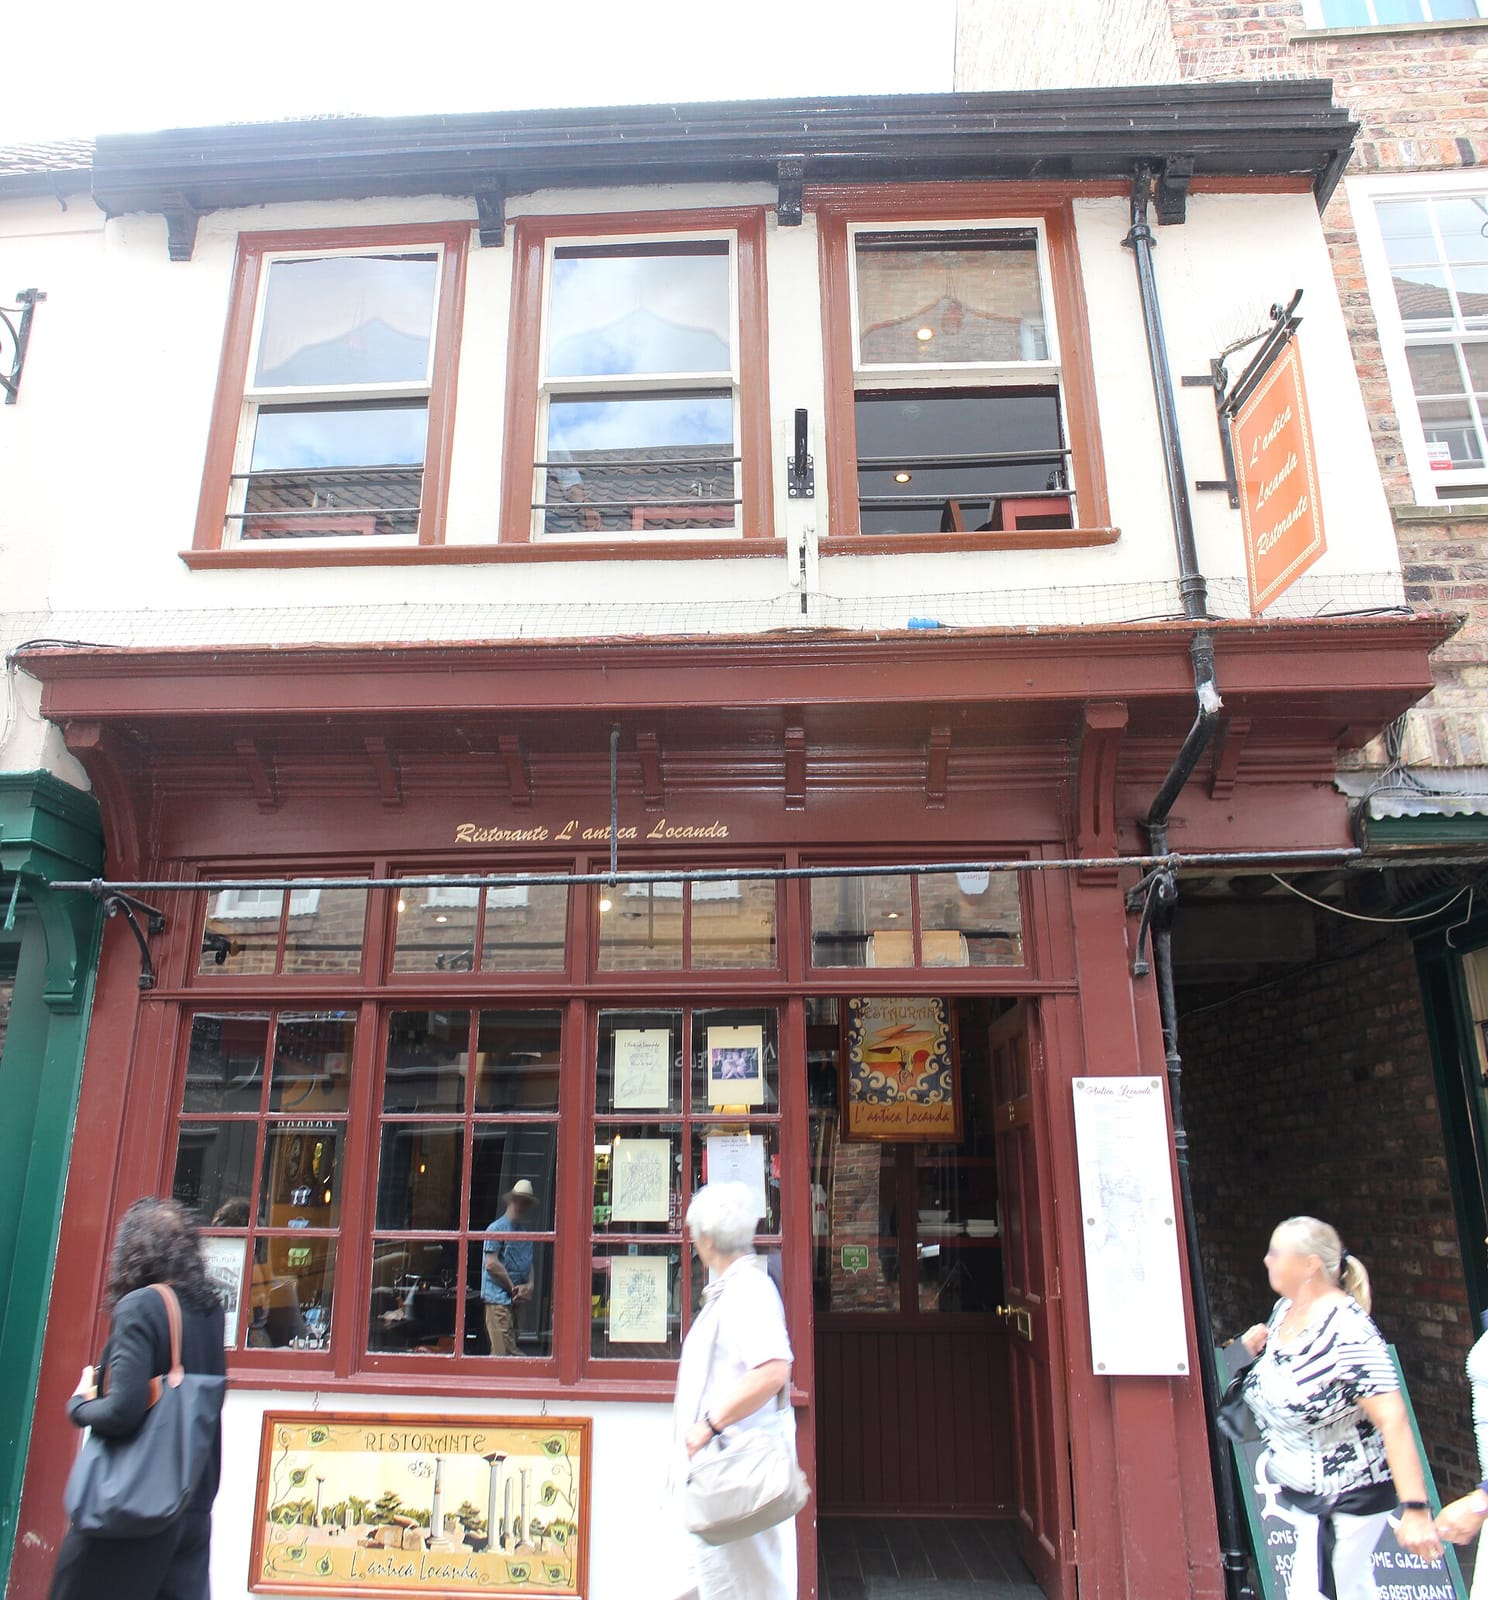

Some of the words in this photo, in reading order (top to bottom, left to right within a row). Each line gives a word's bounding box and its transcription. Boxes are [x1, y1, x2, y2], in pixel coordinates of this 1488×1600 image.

[1255, 450, 1298, 513] Locanda
[1256, 494, 1309, 561] Ristorante
[454, 822, 549, 844] Ristorante
[554, 819, 638, 842] L'antca
[646, 817, 730, 840] Locanda
[905, 1104, 950, 1125] Locanda
[363, 1431, 488, 1454] RISTORANTE
[418, 1553, 480, 1581] Locanda
[1394, 1552, 1429, 1569] GAZE
